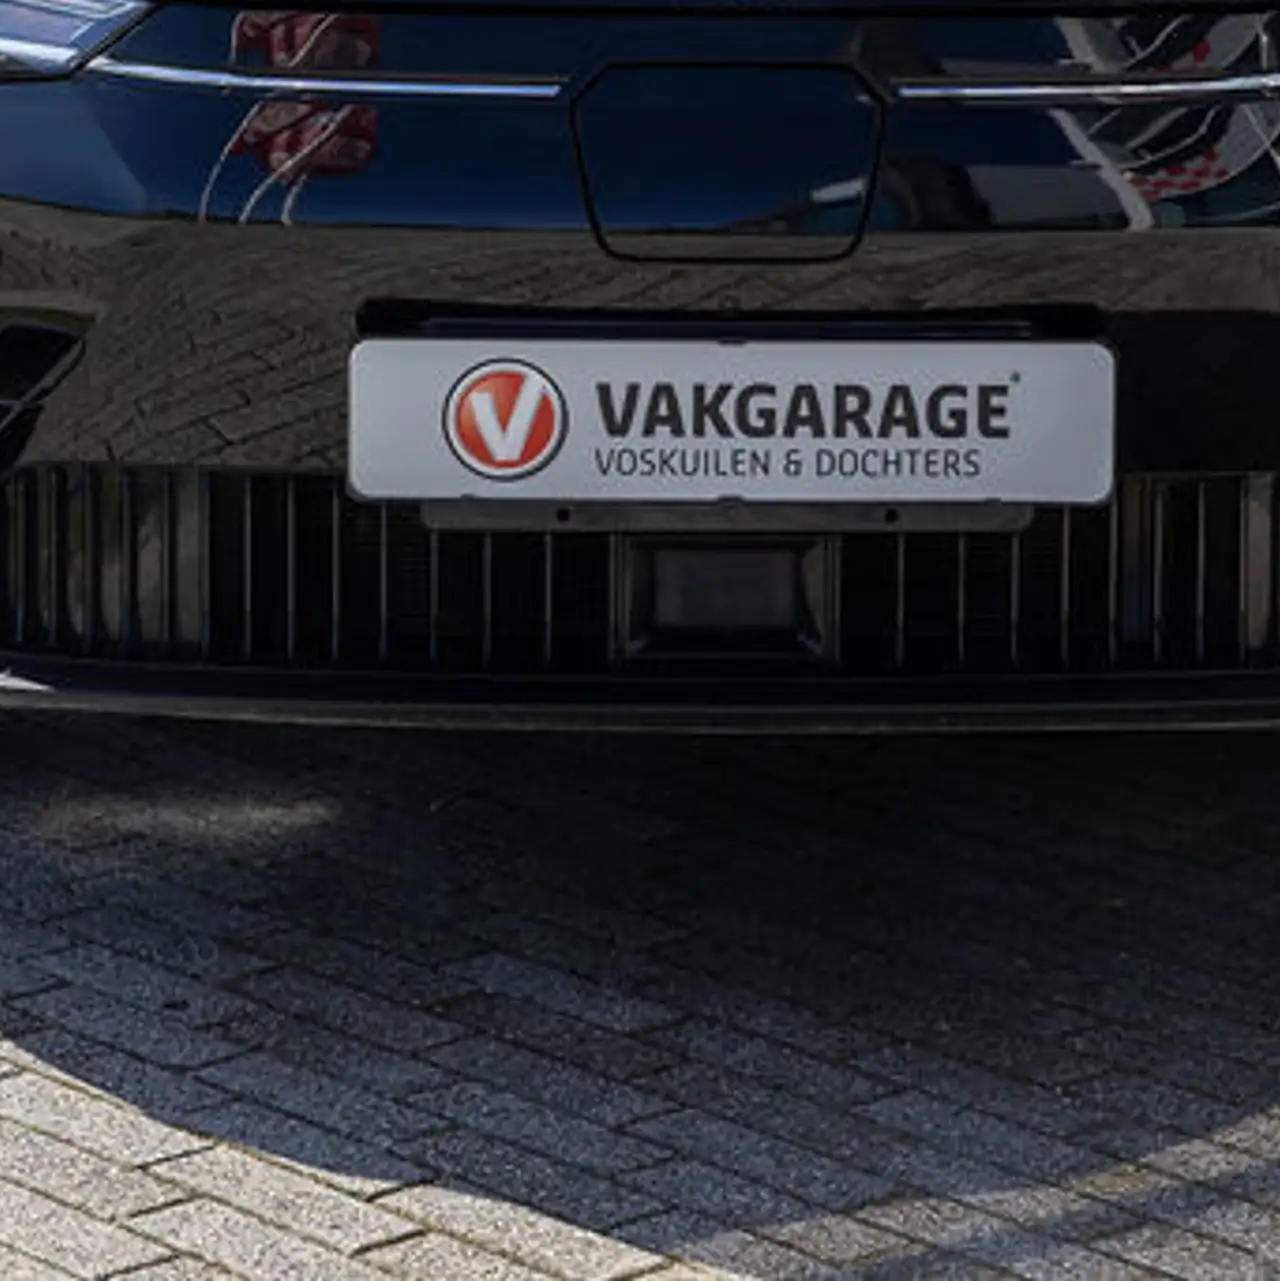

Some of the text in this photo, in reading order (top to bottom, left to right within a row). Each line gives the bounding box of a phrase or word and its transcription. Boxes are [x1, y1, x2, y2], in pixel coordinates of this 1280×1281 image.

[595, 381, 1011, 439] VAKGARAGE
[594, 447, 983, 478] VOSKUILEN & DOCHTERS
